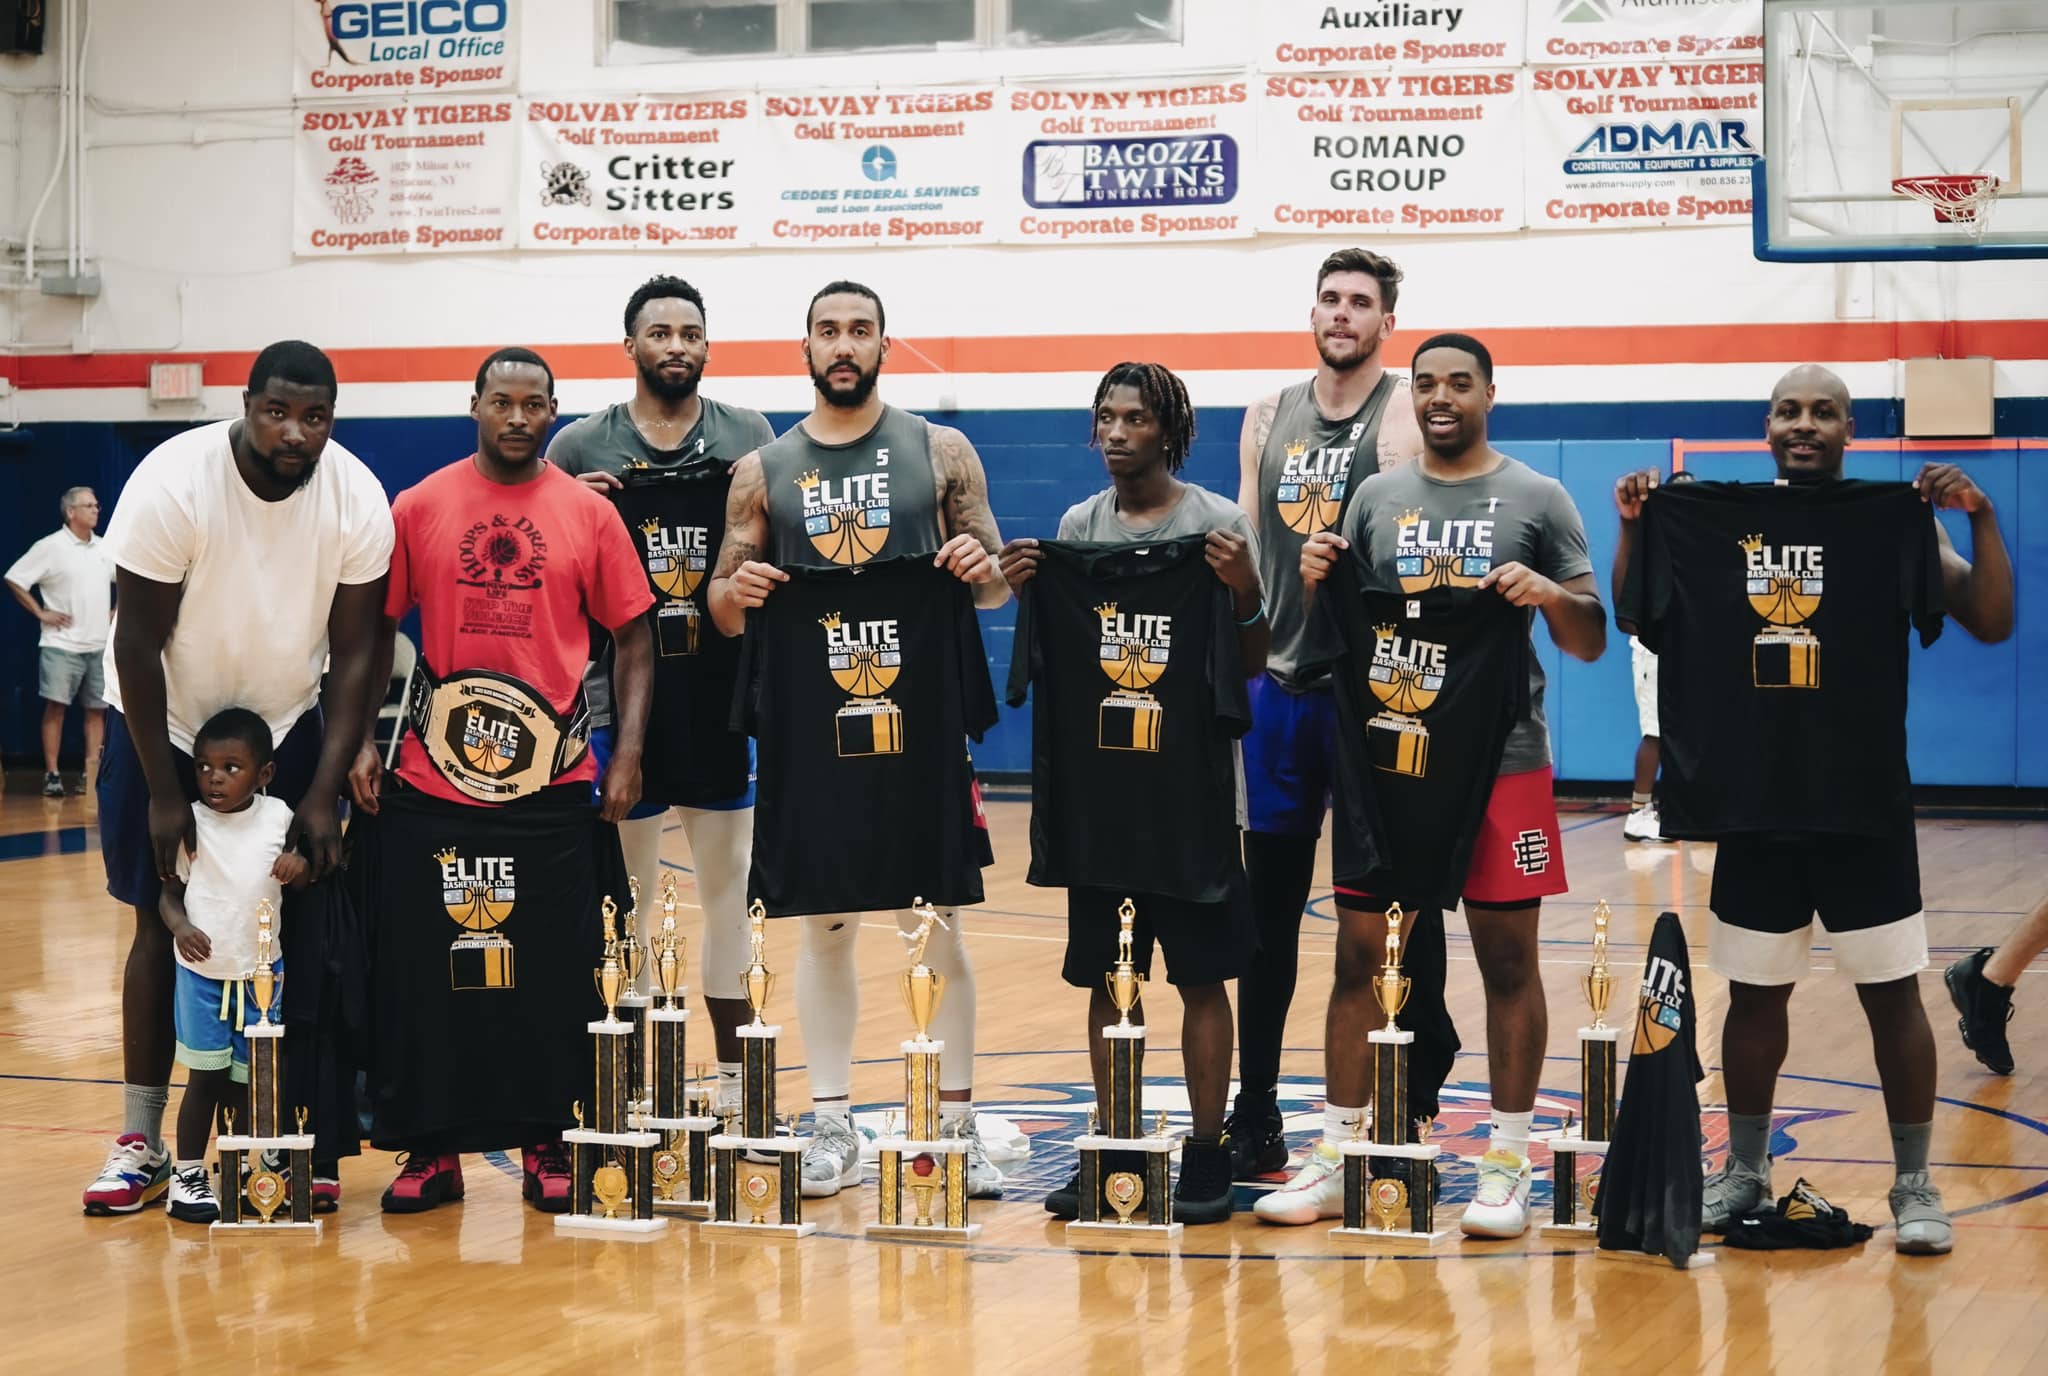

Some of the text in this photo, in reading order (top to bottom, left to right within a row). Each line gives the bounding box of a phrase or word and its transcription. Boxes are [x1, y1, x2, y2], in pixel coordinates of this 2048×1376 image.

[331, 0, 507, 39] GEICO
[1320, 4, 1463, 32] Auxiliary
[370, 36, 504, 62] Local Office
[1277, 39, 1506, 66] Corporate Sponsor
[310, 65, 503, 91] Corporate Sponsor
[1399, 74, 1515, 95] TIGERS
[1533, 63, 1763, 91] SOLVAY TIGER
[765, 91, 993, 117] SOLVAY TIGERS
[1011, 82, 1247, 112] SOLVAY TIGERS
[1567, 94, 1757, 116] Golf Tournament
[303, 102, 512, 131] SOLVAY TIGERS
[528, 99, 747, 124] SOLVAY TIGERS
[1041, 113, 1216, 135] Golf Tournament
[1298, 104, 1483, 124] Golf Tournament
[328, 132, 484, 153] Golf Tournament
[600, 127, 719, 145] Tournament
[794, 121, 964, 141] Golf Tournament
[1573, 120, 1755, 154] ADMAR
[1085, 140, 1224, 167] BAGOZZI
[1313, 134, 1464, 159] ROMANO
[607, 155, 736, 180] Critter
[1086, 164, 1225, 190] TWINS
[1571, 157, 1753, 172] CONSTRUCTION EQUIPMENT & SUPPLIES
[440, 175, 456, 185] NY
[1330, 168, 1446, 192] GROUP
[1565, 177, 1676, 190] www.admarsupply.com
[606, 186, 735, 212] Sitters
[781, 185, 980, 201] GEDDES FEDERAL SAVINGS
[1085, 186, 1225, 202] FUNERAL HOME
[816, 201, 943, 214] and Loan Association
[1275, 204, 1504, 229] Corporate Sponsor
[1546, 196, 1753, 222] Corporate Spons
[310, 225, 503, 251] Corporate Sponsor
[534, 222, 641, 246] Corporate
[773, 217, 984, 242] Corporate Sponsor
[1020, 213, 1239, 240] Corporate Sponsor
[1350, 423, 1364, 440] 8
[876, 448, 889, 466] 5
[1283, 446, 1354, 476] ELITE
[803, 472, 890, 508] ELITE
[1280, 475, 1332, 484] BASKETBALL
[803, 498, 890, 518] BASKETBALL CLUB
[646, 527, 708, 552] ELITE
[1397, 520, 1495, 548] ELITE
[459, 513, 548, 582] HOOPS & DREAMS
[648, 549, 708, 558] BASKETBALL CLUB
[1396, 547, 1493, 557] BASKETBALL CLUB
[1747, 545, 1823, 571] ELITE
[1747, 570, 1823, 579] BASKETBALL CLUB
[828, 620, 899, 647] ELITE
[1101, 613, 1172, 641] ELITE
[828, 643, 900, 655] BASKETBALL CLUB
[1101, 635, 1170, 648] BASKETBALL CLUB
[1374, 636, 1448, 669] ELITE
[1372, 656, 1446, 677] BASKETBALL CLUB
[465, 727, 518, 749] BASKETBALL CLUB
[466, 714, 520, 744] ELITE
[442, 857, 515, 882] ELITE
[443, 880, 515, 889] BASKETBALL CLUB
